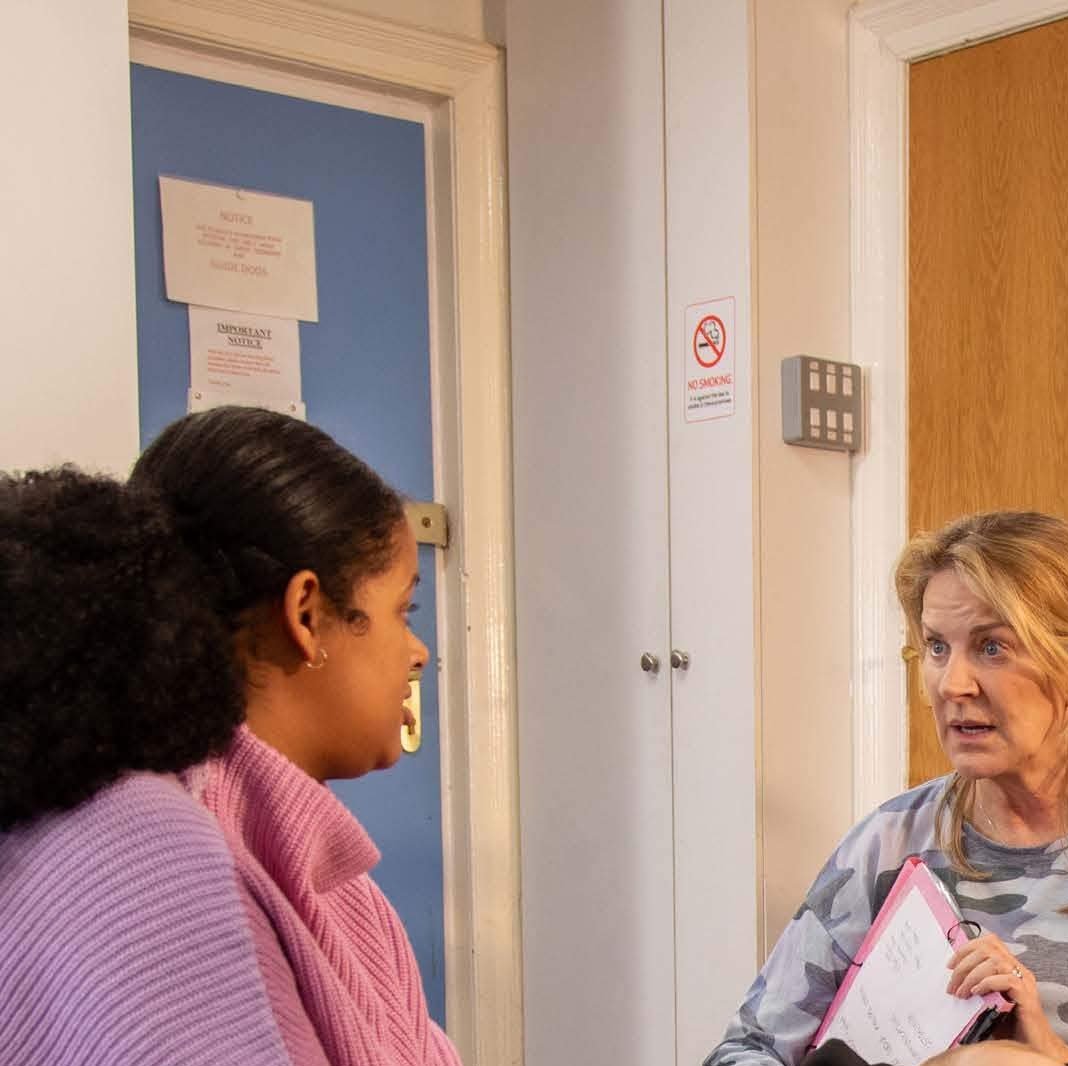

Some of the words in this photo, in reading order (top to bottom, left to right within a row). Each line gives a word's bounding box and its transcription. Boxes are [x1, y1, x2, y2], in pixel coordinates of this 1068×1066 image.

[217, 322, 272, 338] IMPORTANT
[227, 336, 263, 347] NOTICE
[687, 379, 697, 391] NO
[698, 375, 731, 389] SMOKING
